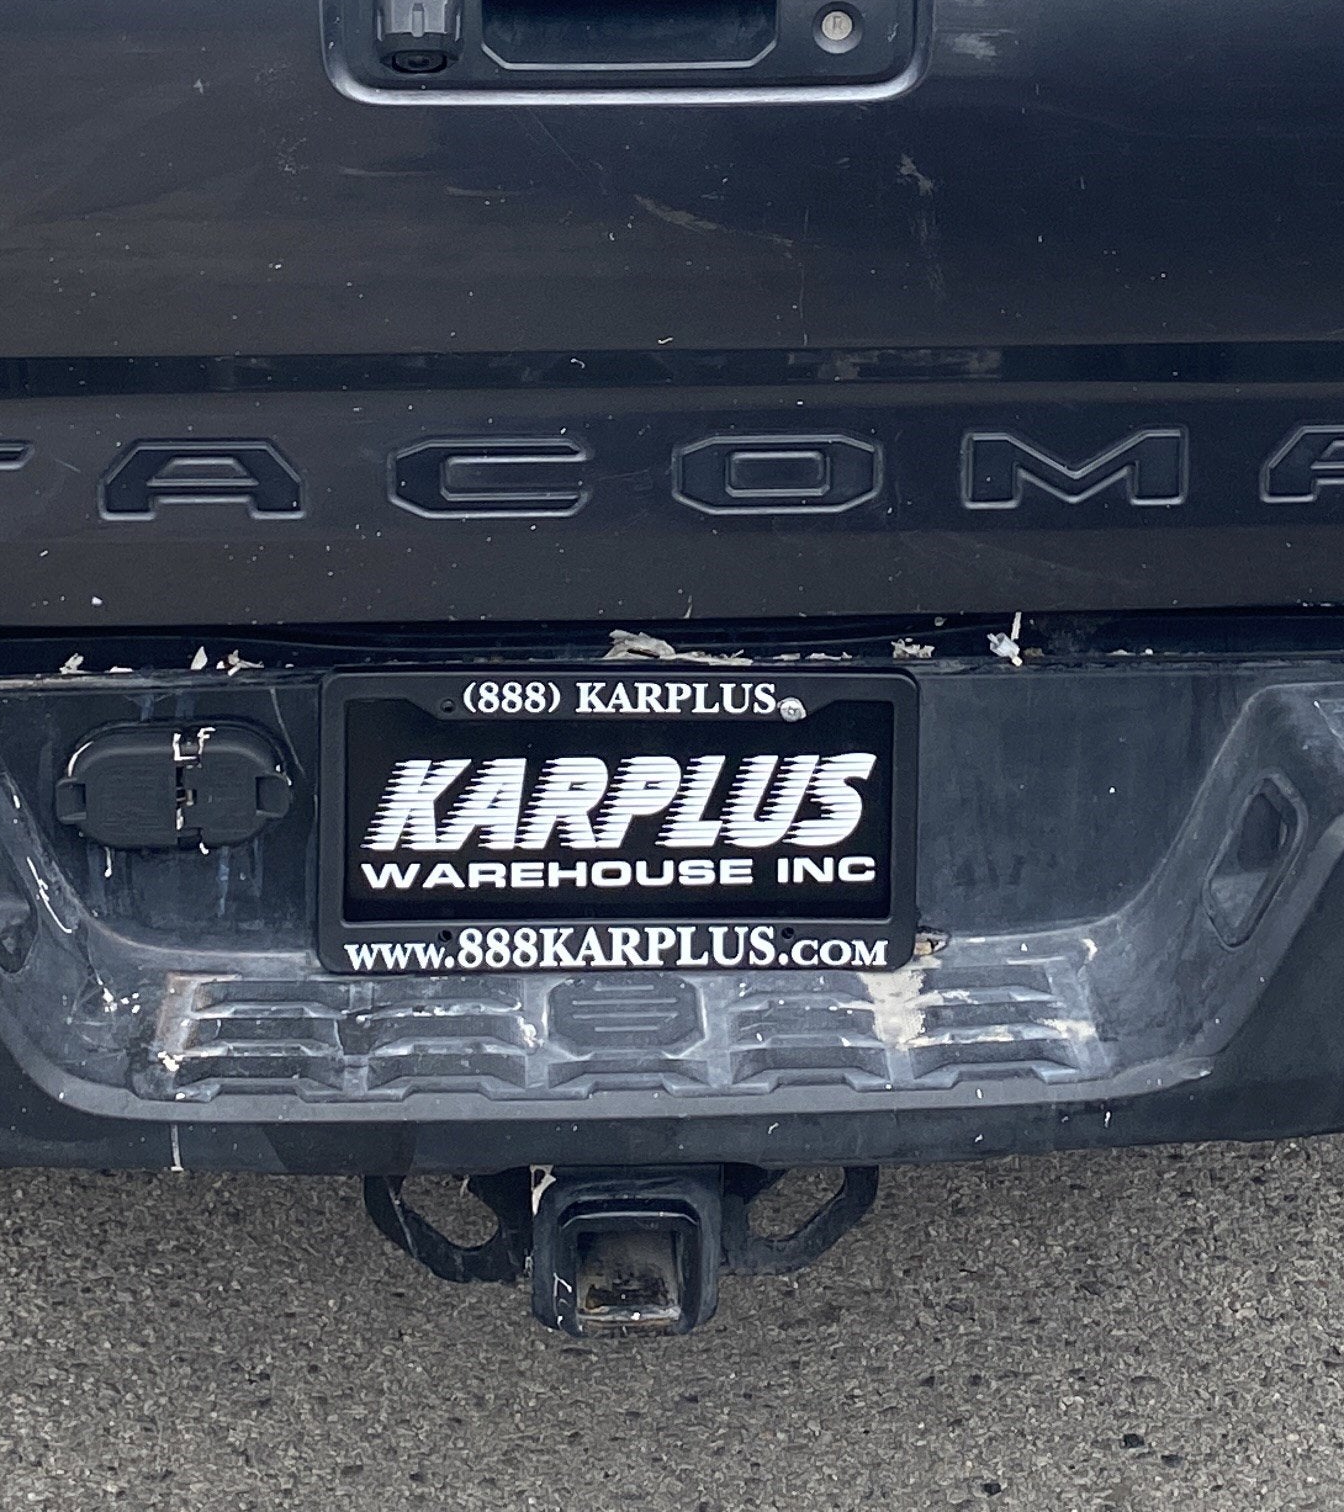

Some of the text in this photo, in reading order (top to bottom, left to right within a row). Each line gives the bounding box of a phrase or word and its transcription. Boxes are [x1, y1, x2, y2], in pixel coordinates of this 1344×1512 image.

[462, 682, 777, 715] (888) KARPLUS
[360, 753, 877, 851] KARPLUS
[360, 856, 876, 889] WAREHOUSE INC
